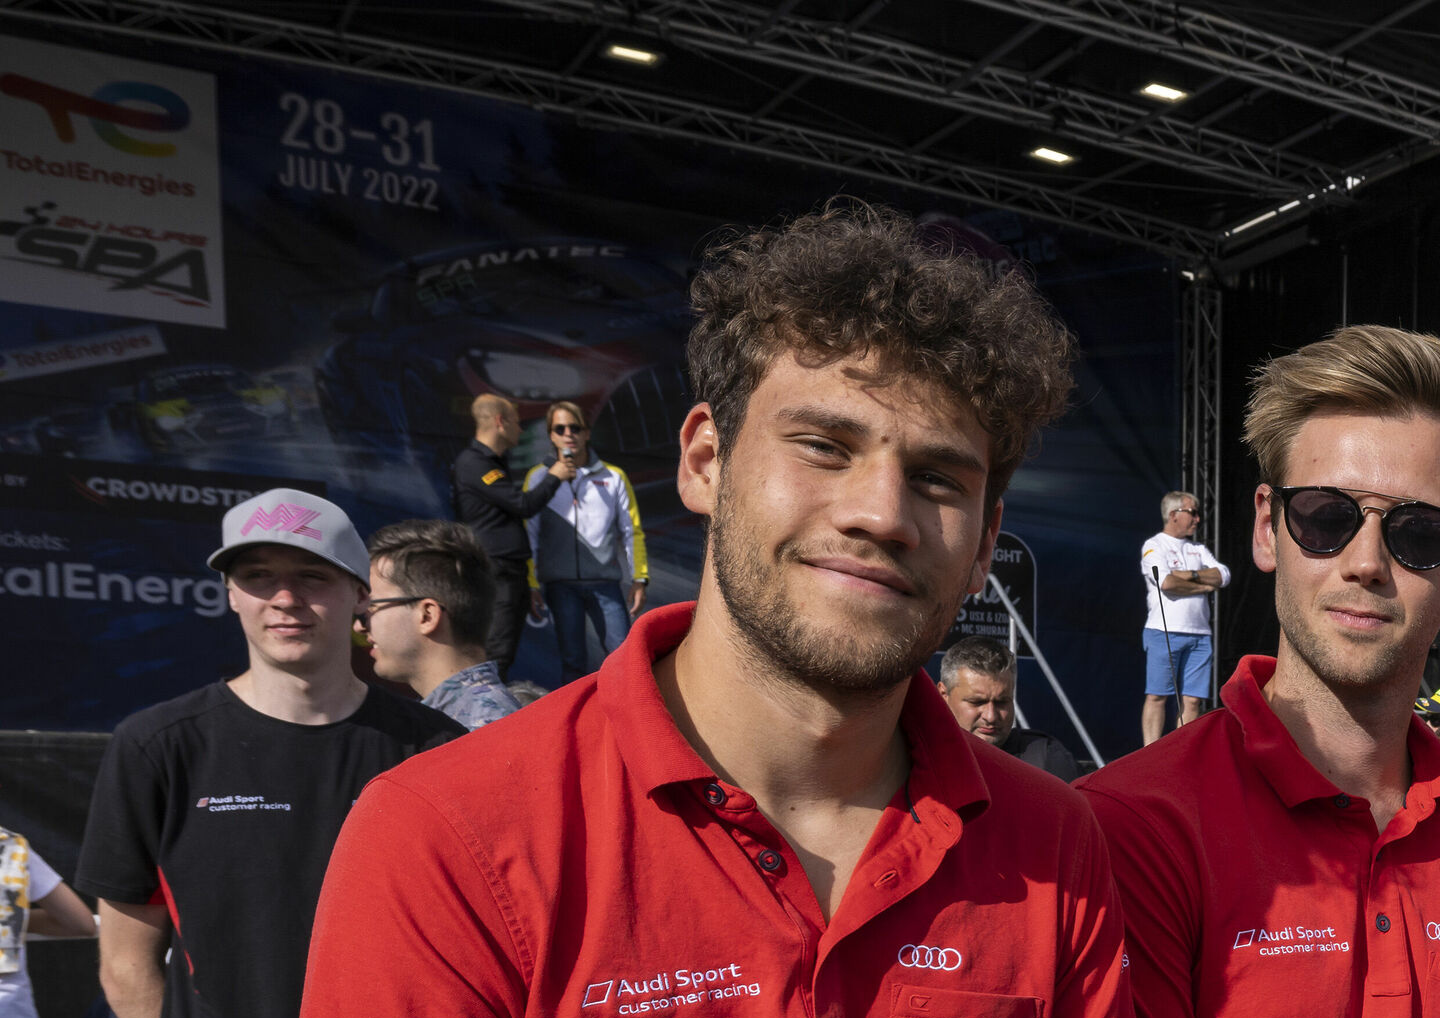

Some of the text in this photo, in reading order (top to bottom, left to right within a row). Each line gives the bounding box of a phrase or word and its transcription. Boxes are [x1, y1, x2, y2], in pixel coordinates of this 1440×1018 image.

[1, 150, 196, 197] TotalEnergies
[280, 158, 440, 211] JULY 2022
[16, 227, 211, 304] SPA
[415, 246, 626, 285] FANATEC
[86, 476, 260, 508] CROWDSTR
[0, 561, 229, 618] alEnerg
[209, 795, 264, 804] Audi Sport
[209, 802, 291, 812] customer racing
[1258, 925, 1336, 944] Audi Sport
[1259, 940, 1350, 957] customer racing
[617, 962, 742, 997] Audi Sport
[618, 980, 761, 1015] customer racing
